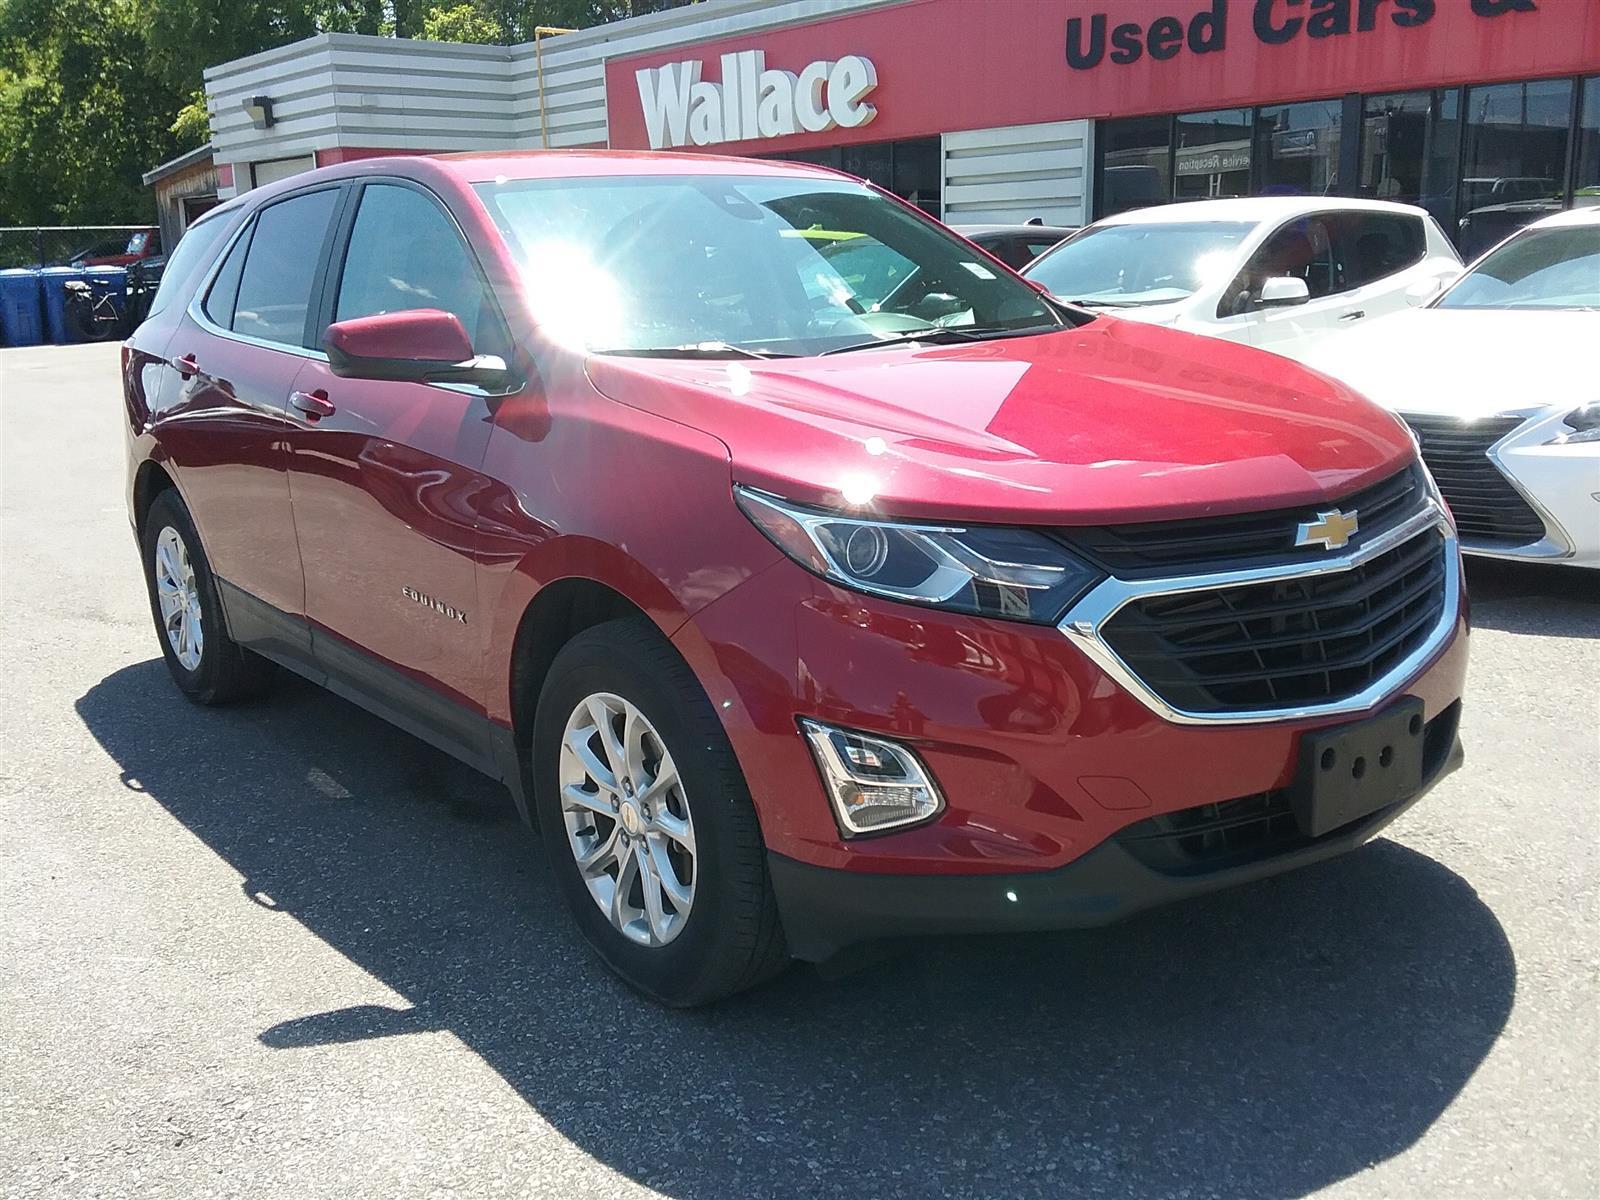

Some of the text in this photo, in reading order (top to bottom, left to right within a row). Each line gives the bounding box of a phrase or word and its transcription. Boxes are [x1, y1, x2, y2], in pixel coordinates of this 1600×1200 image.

[1065, 0, 1434, 70] Used Cars
[635, 49, 878, 150] Wallace
[401, 585, 468, 625] EQUINOX
